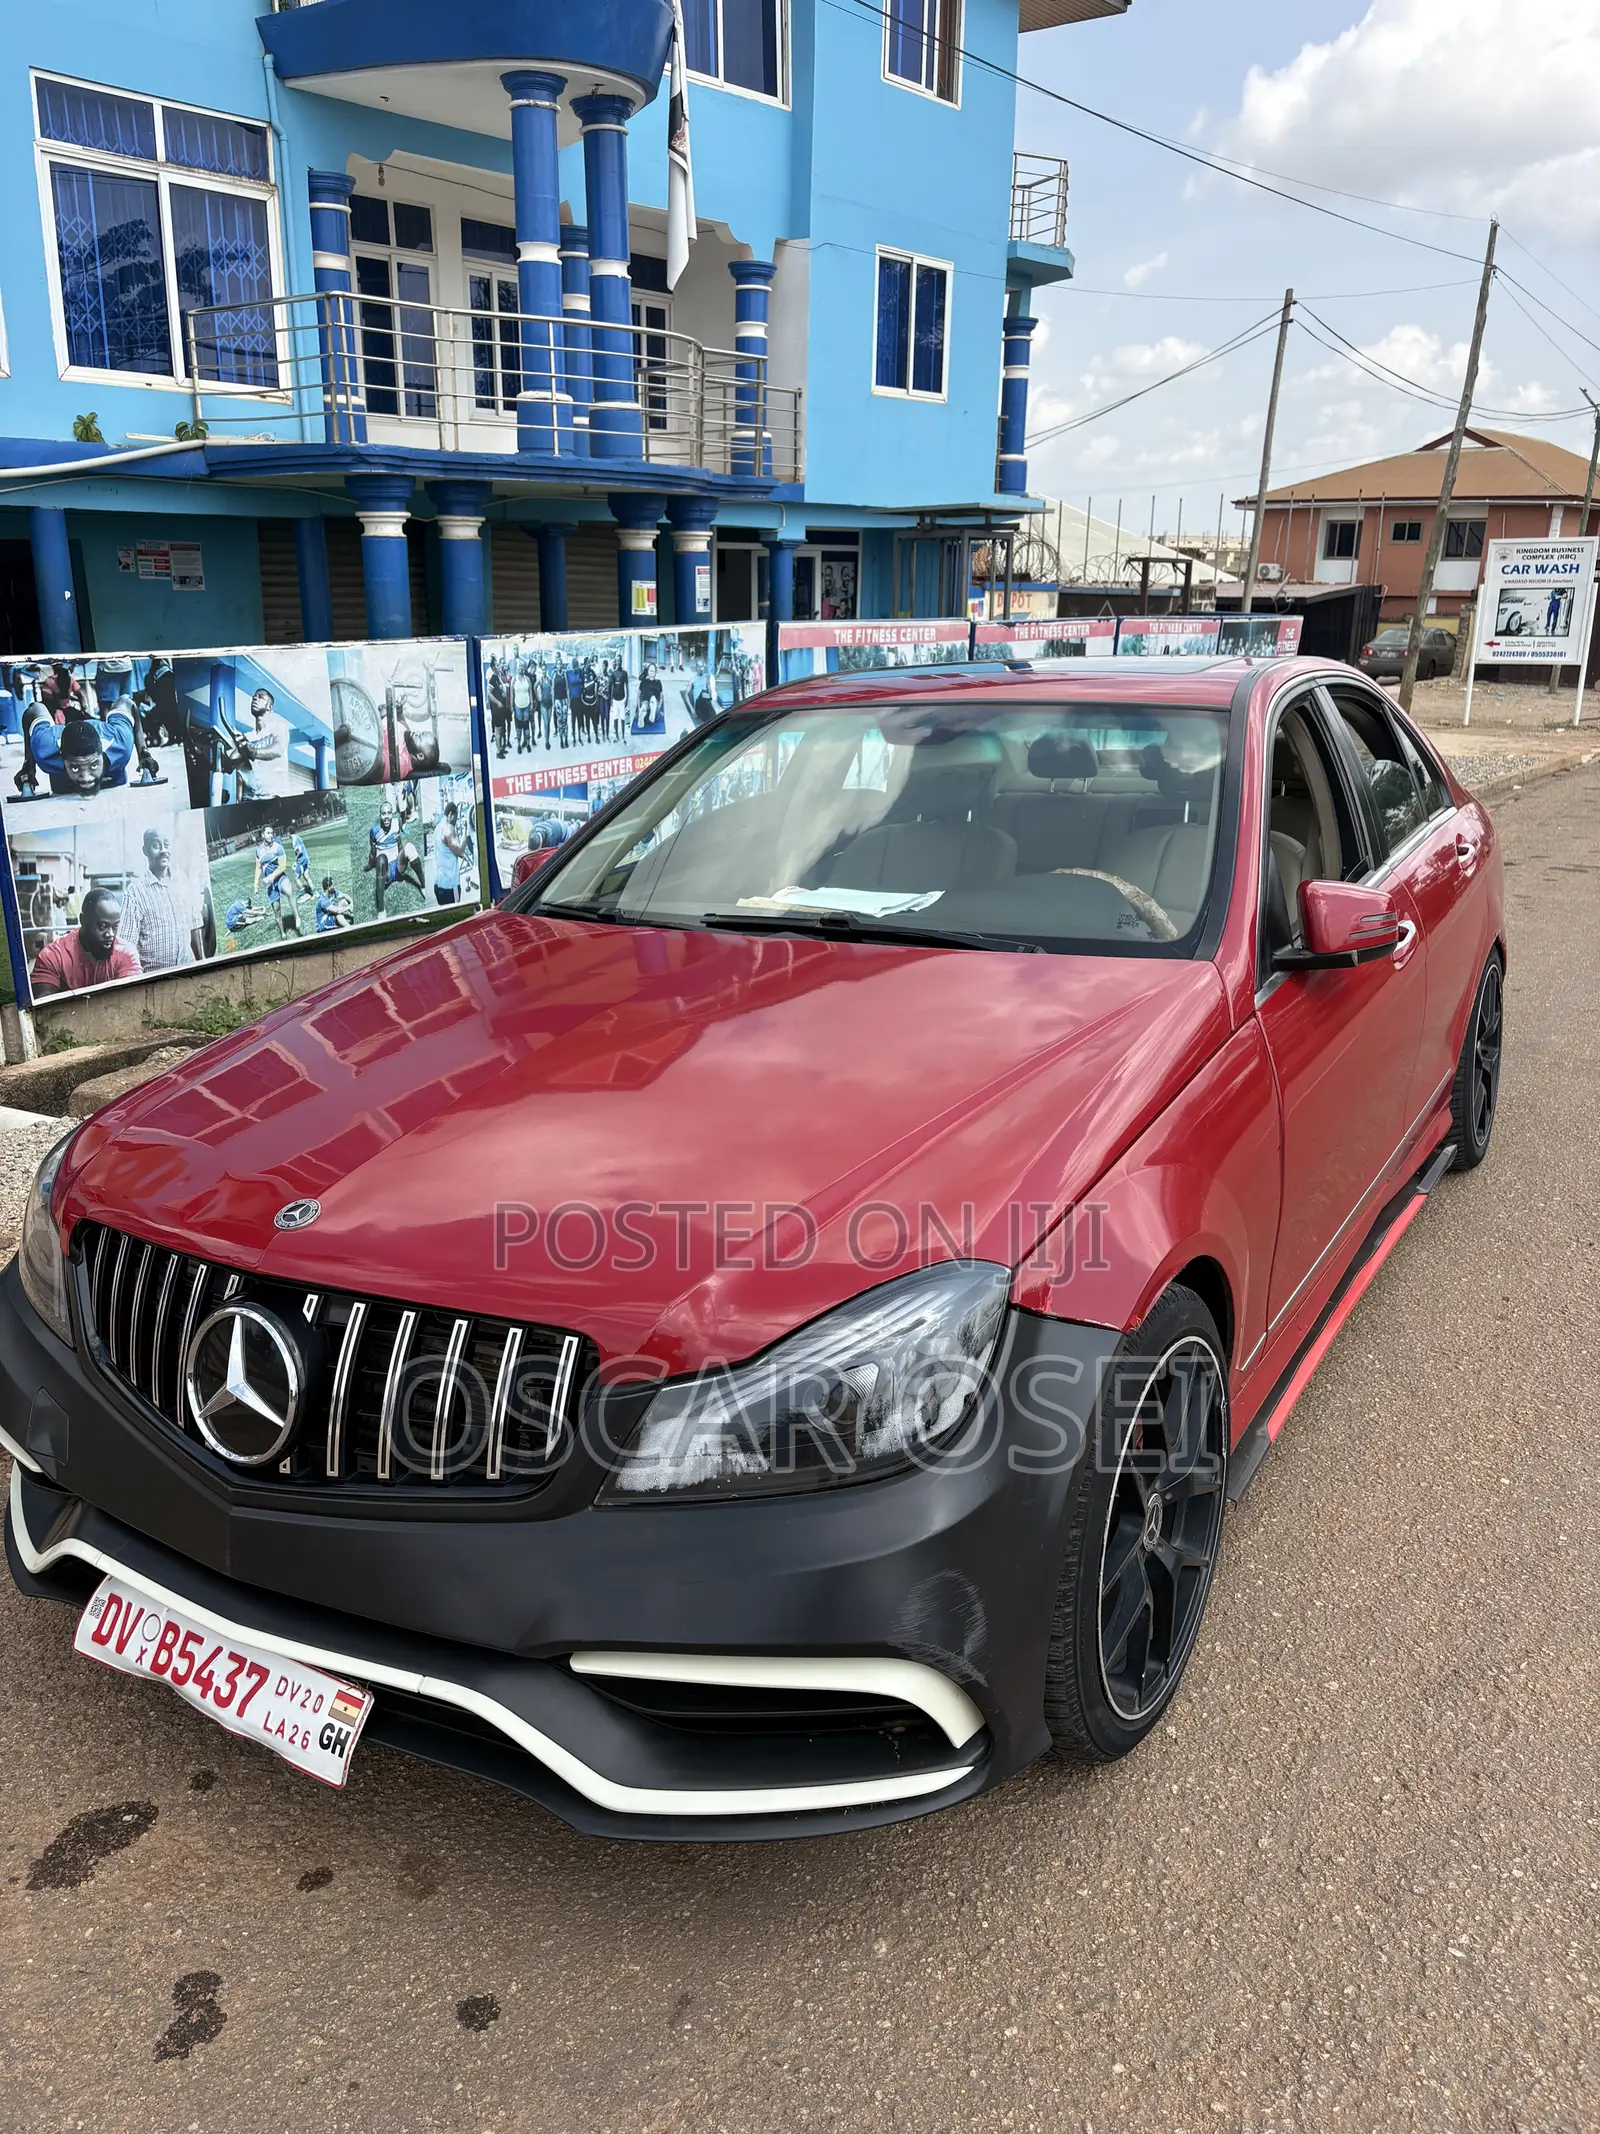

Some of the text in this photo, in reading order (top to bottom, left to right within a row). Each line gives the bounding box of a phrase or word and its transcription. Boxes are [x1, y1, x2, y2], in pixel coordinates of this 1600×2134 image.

[1501, 563, 1580, 574] CAR WASH
[997, 592, 1032, 608] DPOT
[834, 627, 936, 644] THE FITNESS CENTER
[1014, 624, 1090, 640] THE FITNESS CENTER
[1149, 622, 1158, 633] THE
[1285, 628, 1296, 639] THE
[506, 773, 533, 794] THE
[535, 765, 588, 790] FITNESS
[590, 757, 633, 780] CENTER
[91, 1593, 270, 1718] DV B5437
[275, 1676, 324, 1714] DV20
[263, 1711, 311, 1750] LA26
[319, 1723, 351, 1758] GH
